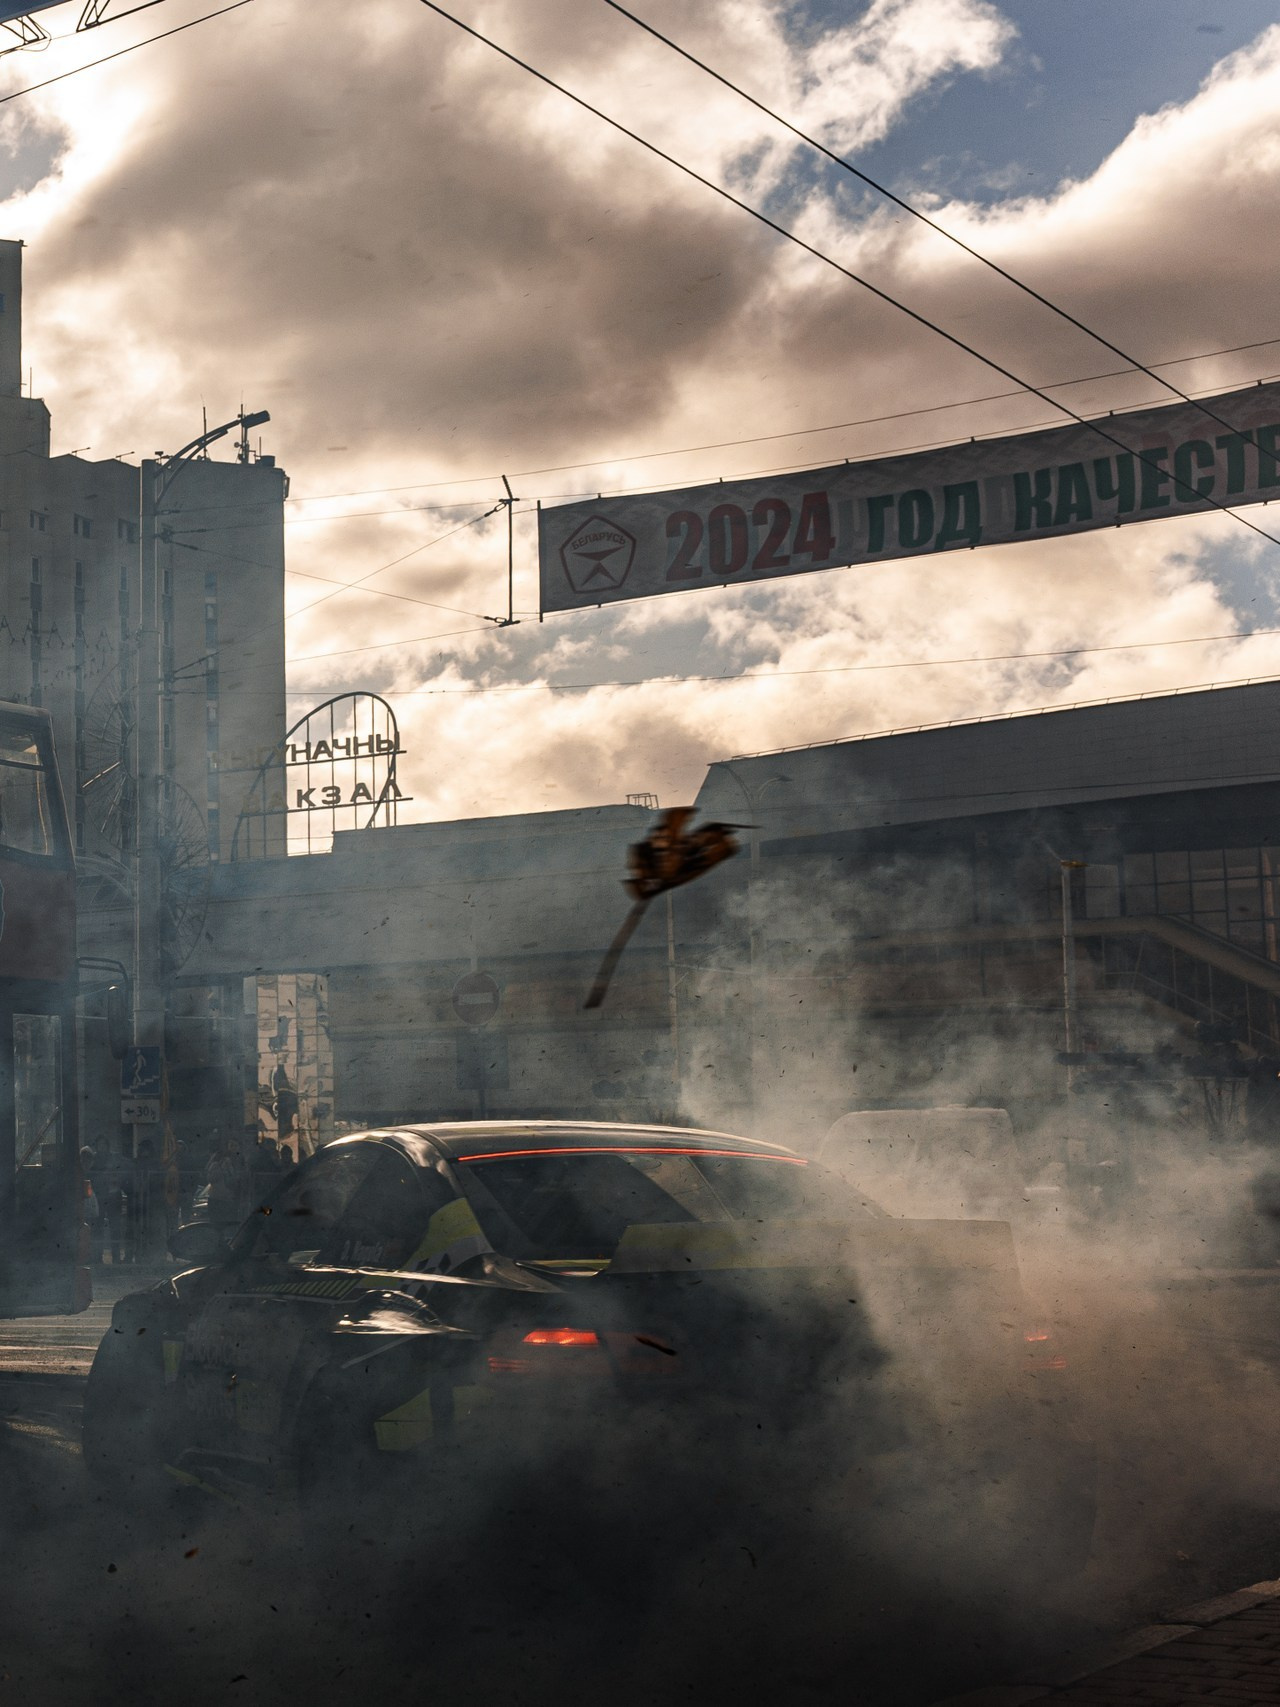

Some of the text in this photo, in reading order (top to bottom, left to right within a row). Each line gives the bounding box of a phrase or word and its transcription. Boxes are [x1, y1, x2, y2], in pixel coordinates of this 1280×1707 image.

[571, 532, 626, 550] БЕЛАРУСЬ
[665, 491, 837, 582] 2024
[865, 479, 983, 555] ГОД
